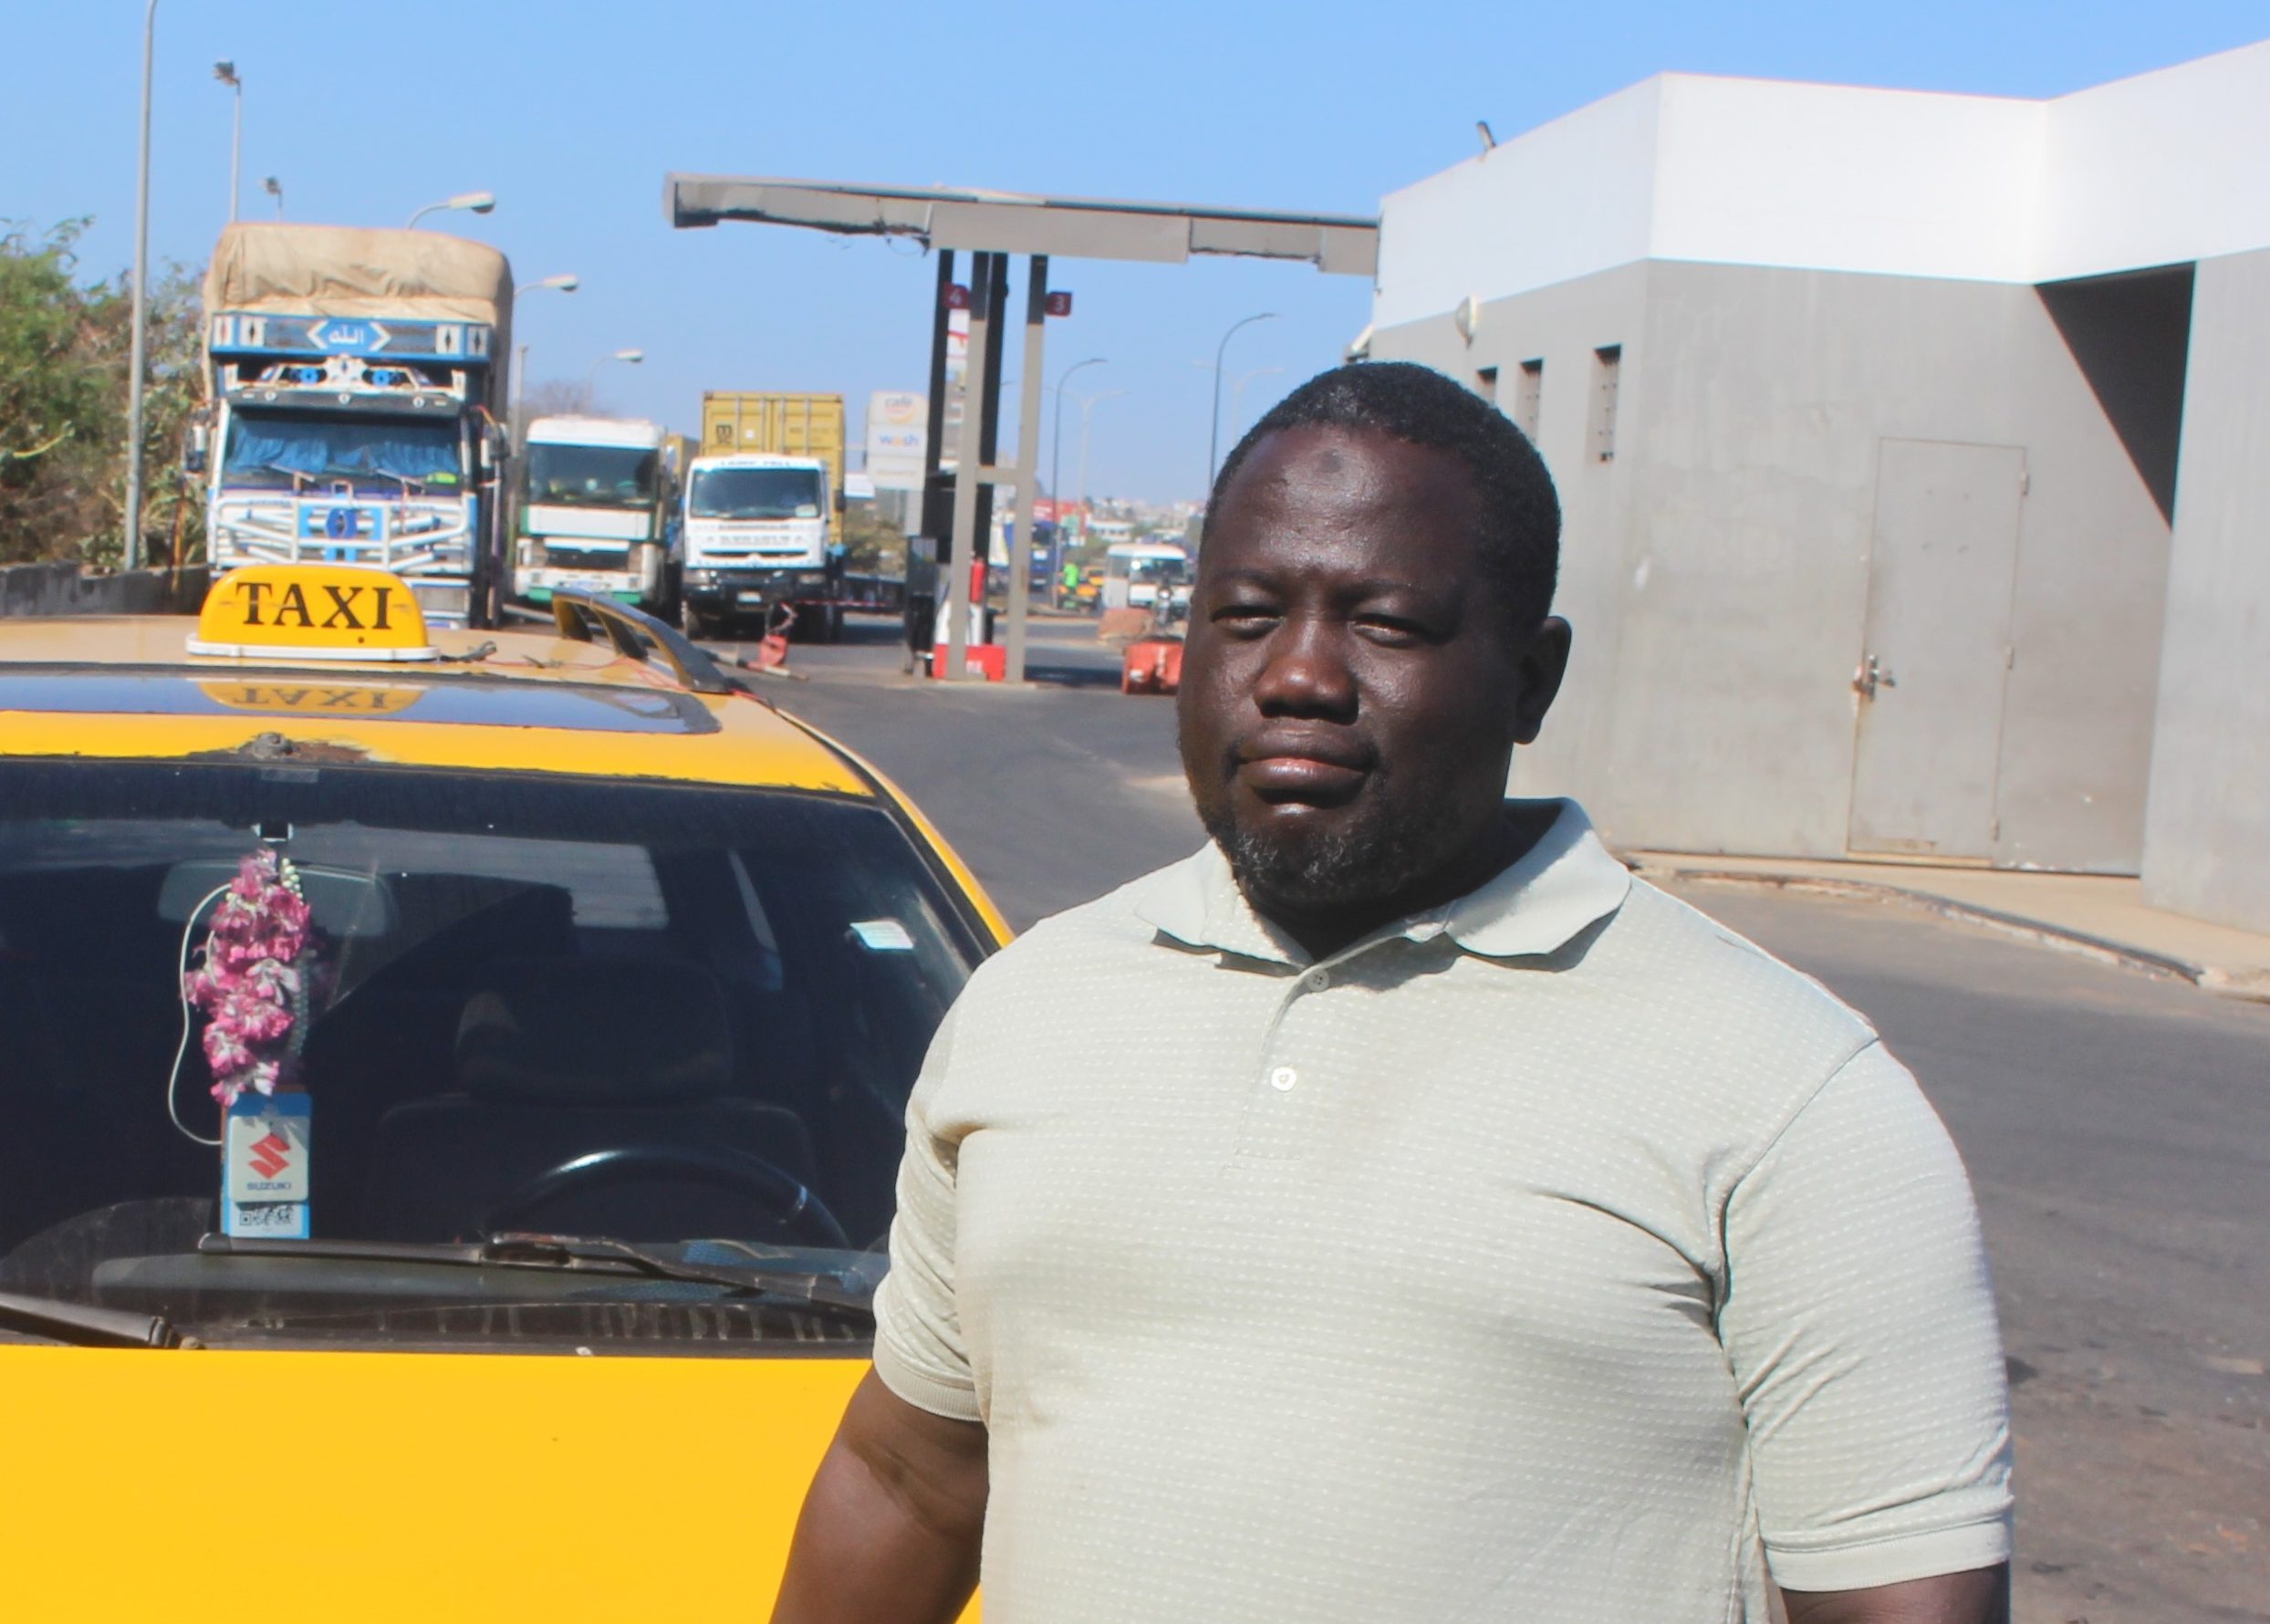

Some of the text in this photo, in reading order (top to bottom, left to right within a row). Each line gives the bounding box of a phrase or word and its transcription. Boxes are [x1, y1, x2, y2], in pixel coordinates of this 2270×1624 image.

[1054, 297, 1066, 312] 3
[328, 324, 364, 344] الله
[879, 431, 918, 446] wash
[235, 582, 392, 630] TAXI
